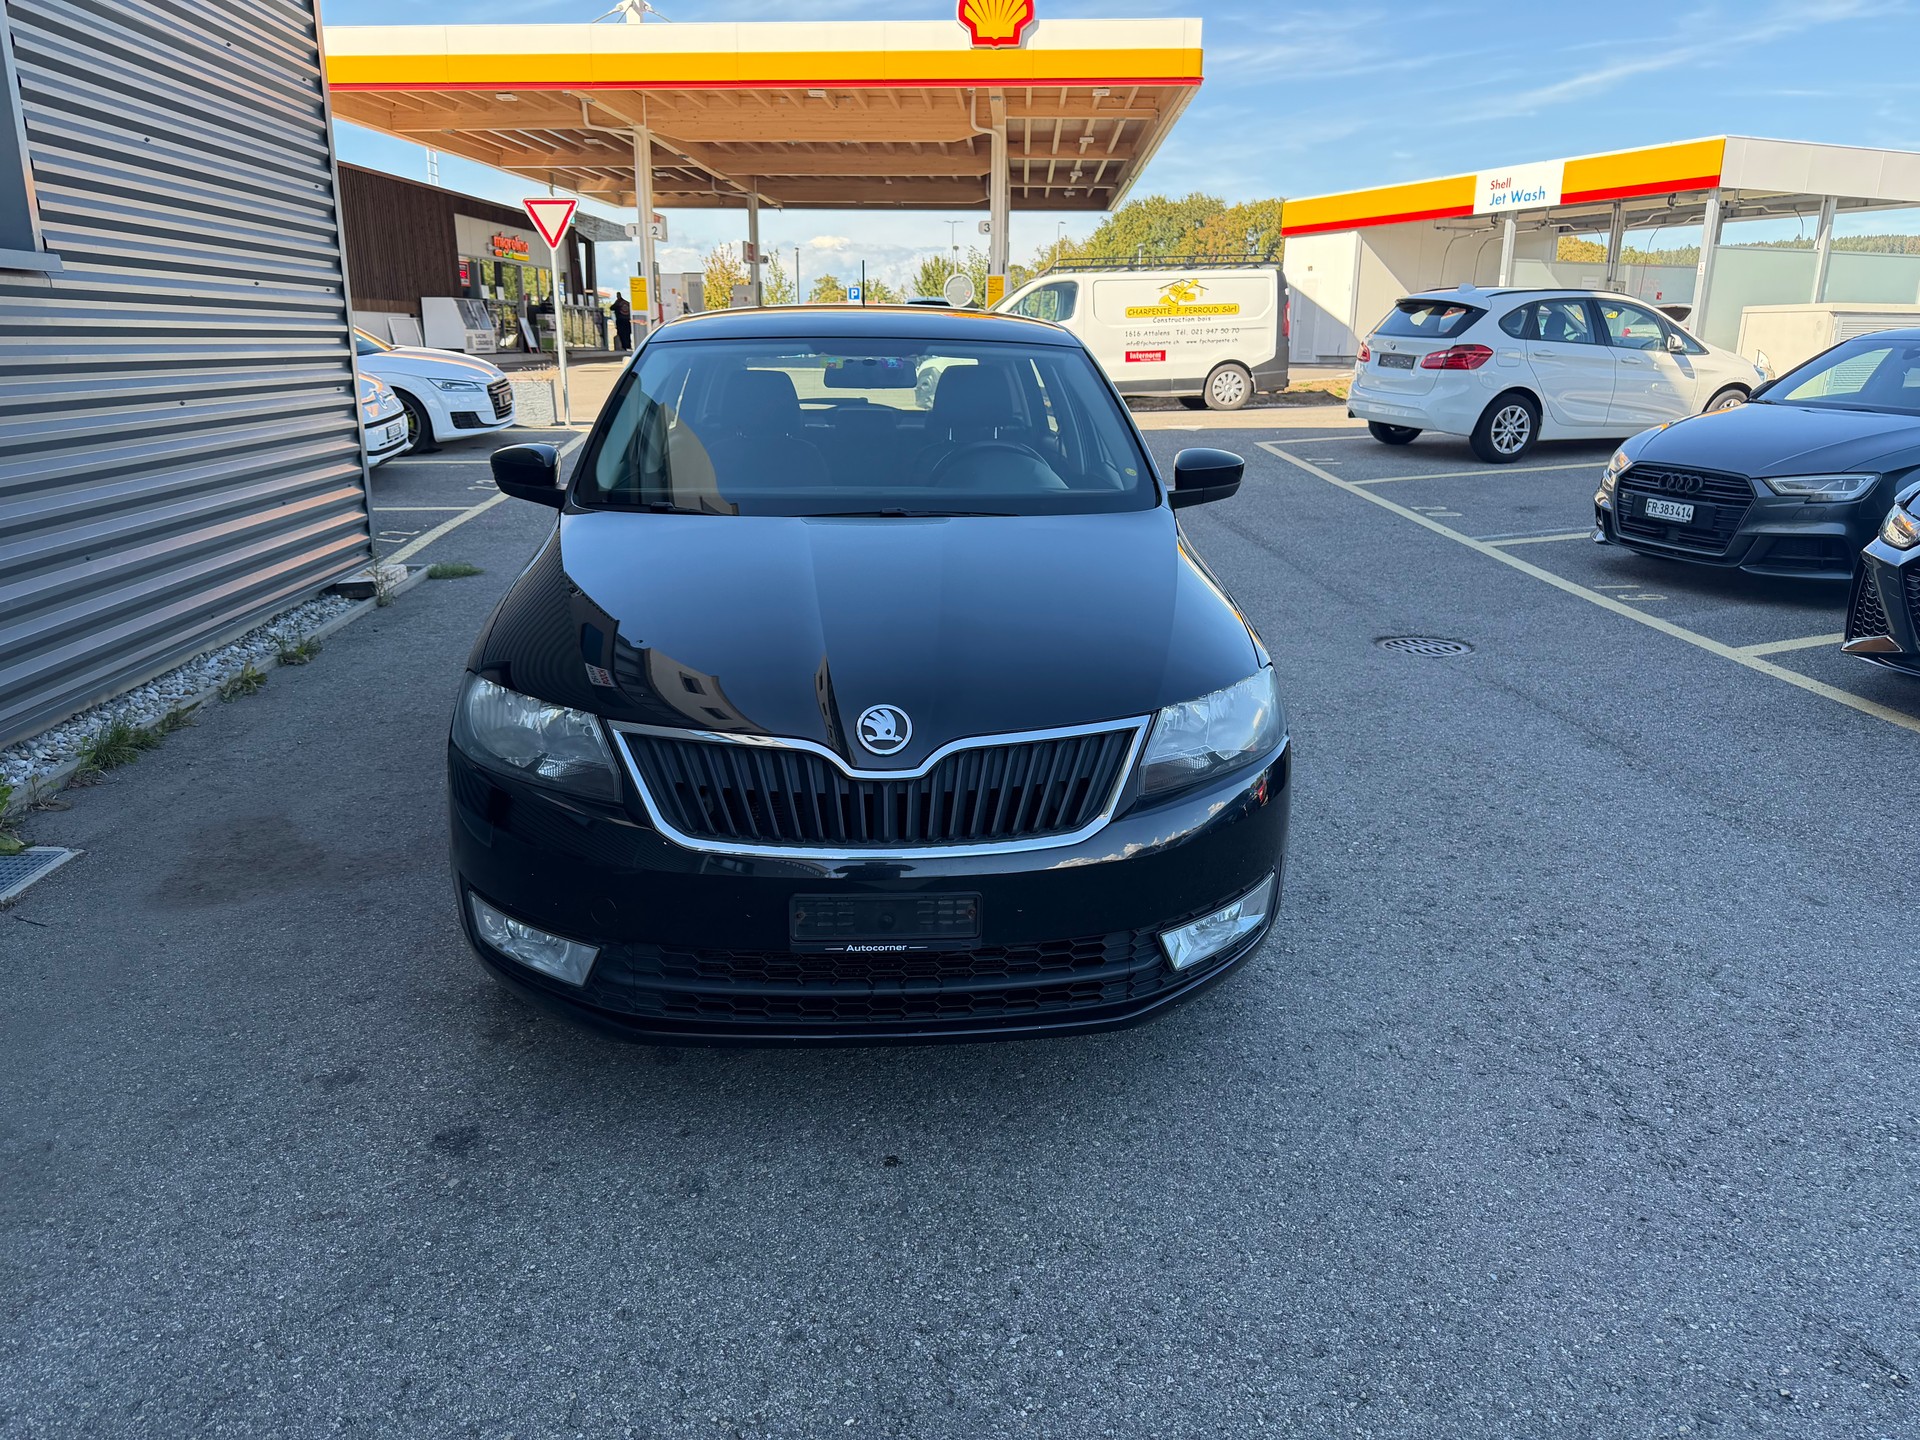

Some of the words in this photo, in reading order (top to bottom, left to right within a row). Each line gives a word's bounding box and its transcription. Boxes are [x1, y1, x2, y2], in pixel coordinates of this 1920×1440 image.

[1490, 177, 1512, 190] Shell
[1489, 193, 1506, 206] Jet
[1511, 185, 1546, 203] Wash
[651, 225, 658, 235] 2
[984, 222, 991, 232] 3
[1127, 307, 1172, 316] CHARPENTE
[1130, 351, 1162, 359] Internorm
[846, 944, 907, 952] Autocorner
